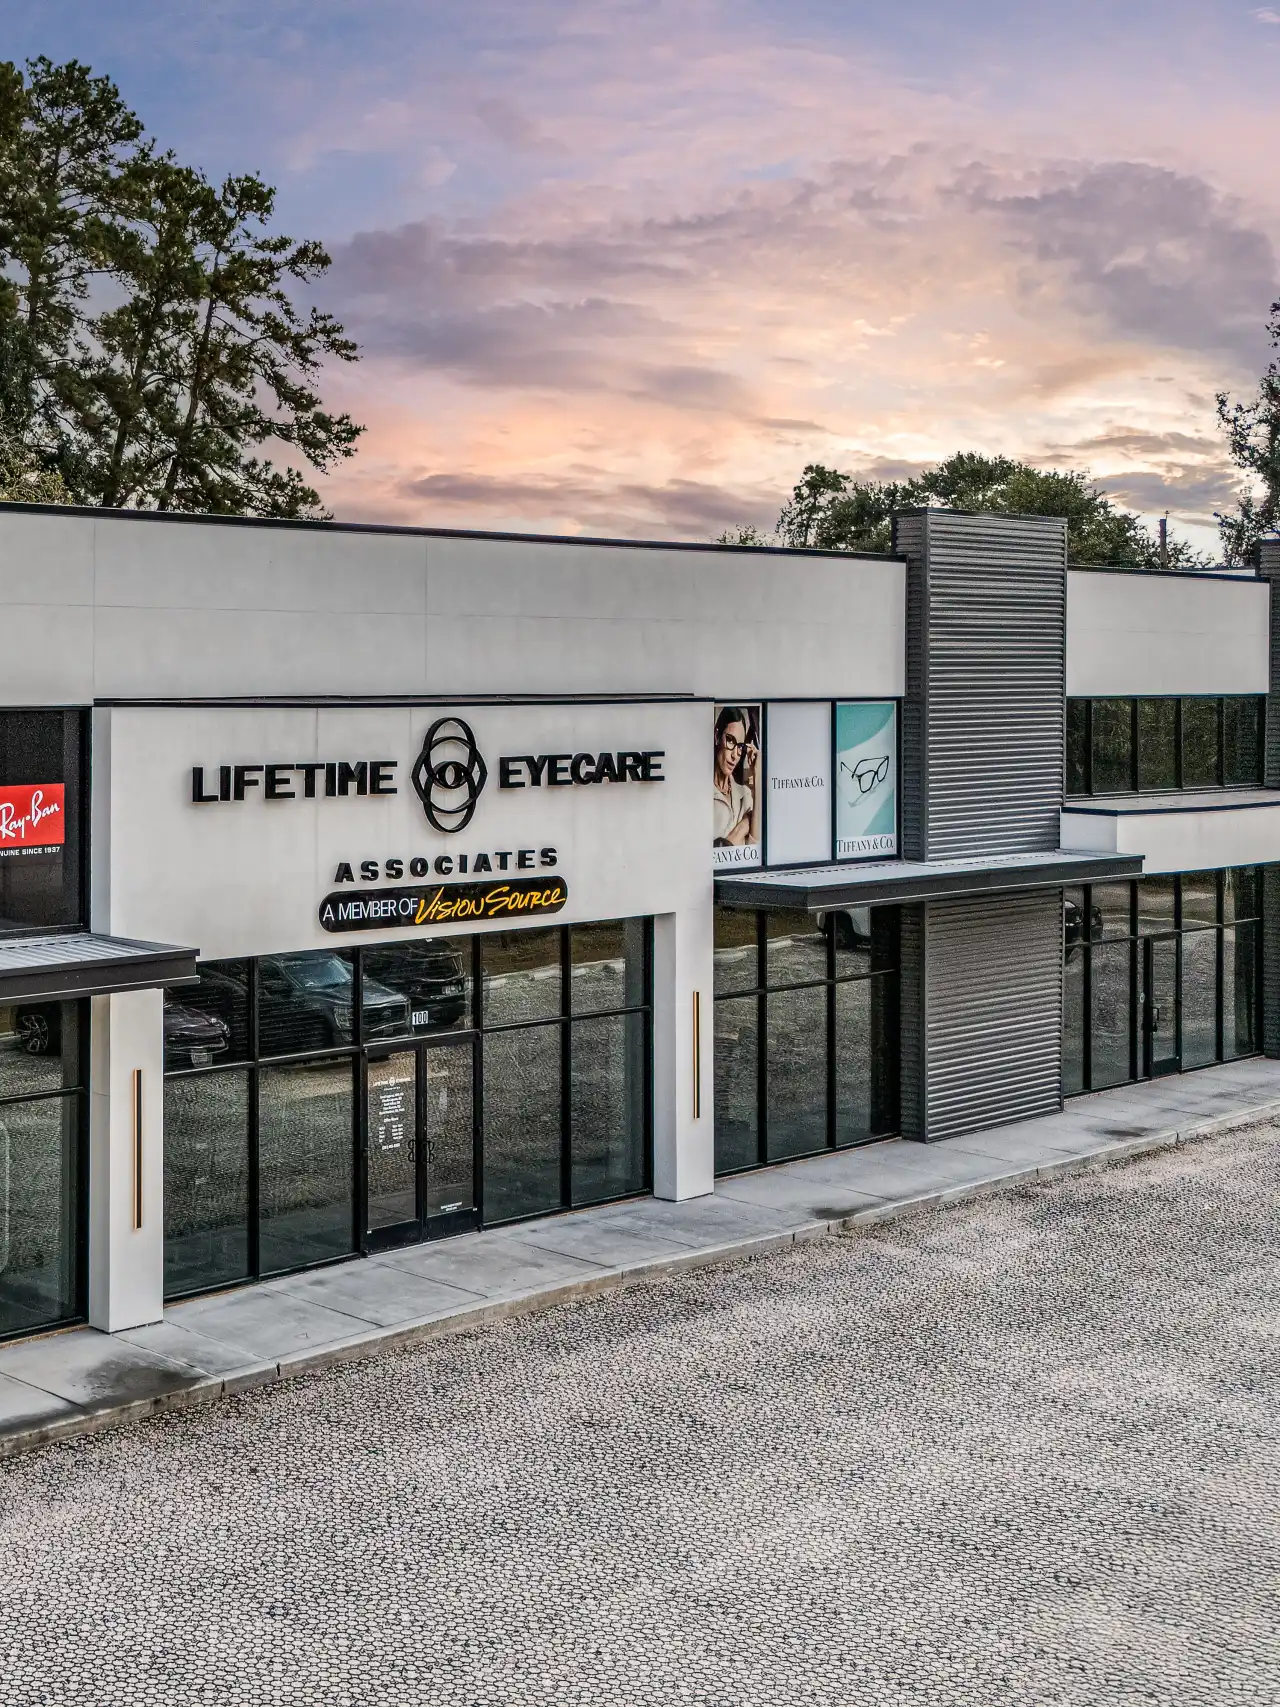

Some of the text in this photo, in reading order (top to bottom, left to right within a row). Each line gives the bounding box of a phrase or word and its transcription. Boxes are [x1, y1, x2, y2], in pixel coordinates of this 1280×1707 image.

[192, 751, 666, 803] LIFETIME EYECARE
[22, 847, 42, 855] SINCE
[334, 847, 558, 884] ASSOCIATES
[322, 904, 335, 922] A
[338, 899, 397, 921] MEMBER
[398, 897, 419, 916] OF
[413, 1011, 427, 1024] 100
